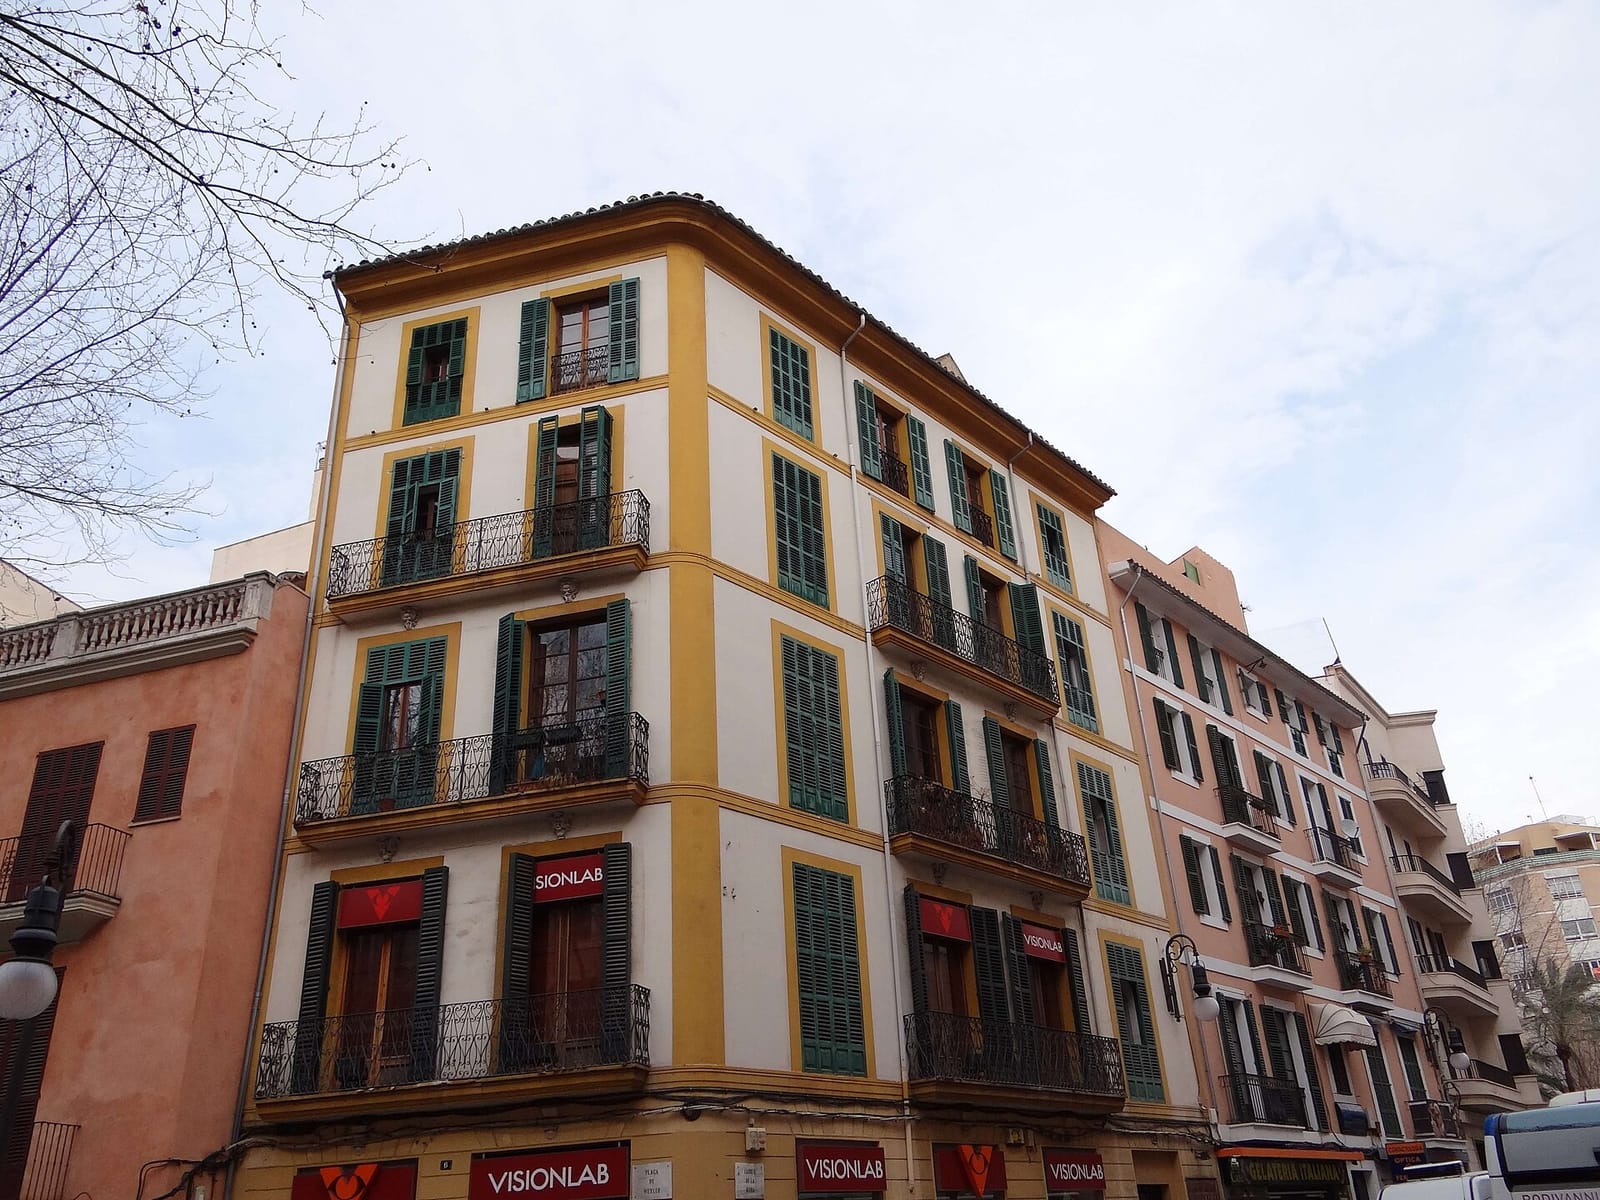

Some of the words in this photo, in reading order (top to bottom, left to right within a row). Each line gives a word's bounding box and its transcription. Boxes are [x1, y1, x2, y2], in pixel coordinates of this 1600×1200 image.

[535, 867, 604, 890] SIONLAB
[1023, 933, 1063, 953] VISIONLAB
[488, 1163, 610, 1194] VISIONLAB
[805, 1158, 884, 1179] VISIONLAB
[1049, 1163, 1104, 1180] VISIONLAB
[1248, 1161, 1299, 1180] GELATERIA
[1300, 1162, 1341, 1181] ITALIANA
